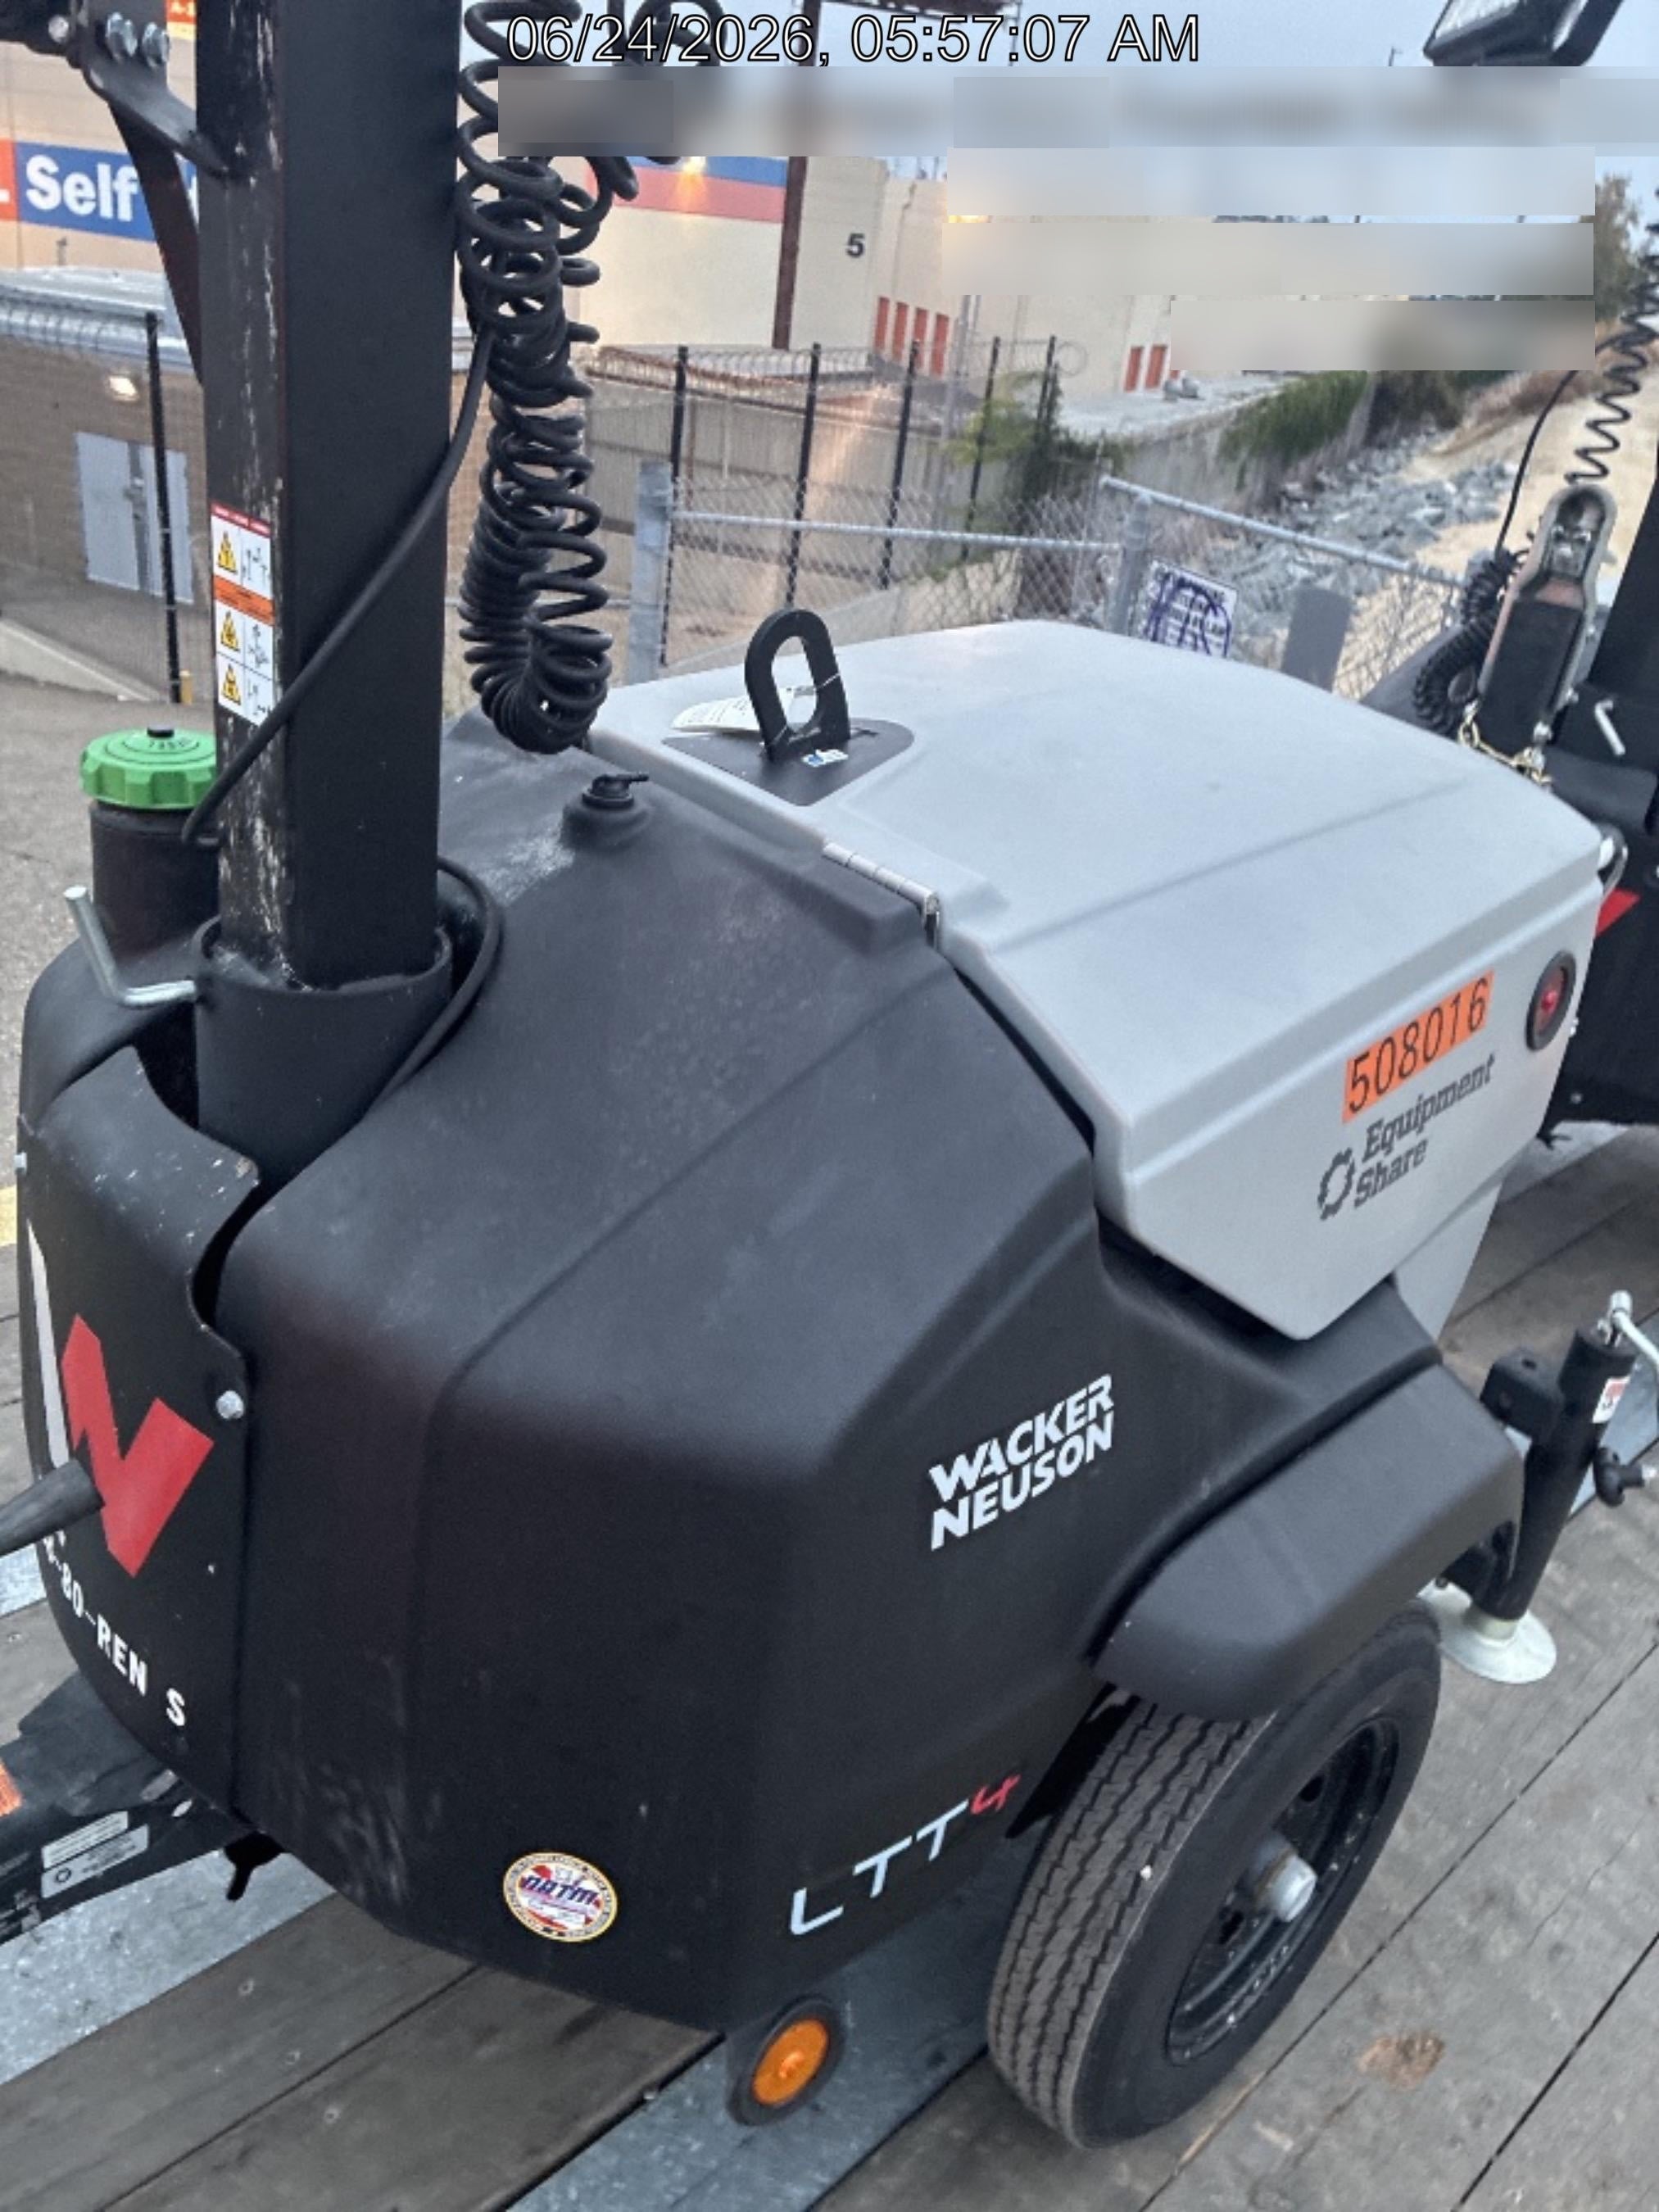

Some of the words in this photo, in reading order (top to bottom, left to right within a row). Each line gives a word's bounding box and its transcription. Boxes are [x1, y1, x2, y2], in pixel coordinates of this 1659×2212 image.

[26, 155, 138, 222] Self
[846, 233, 864, 258] 5
[1349, 977, 1489, 1113] 508016
[1362, 1052, 1495, 1163] Equipment
[1353, 1139, 1428, 1209] Share
[929, 1373, 1114, 1502] WACKER
[931, 1410, 1114, 1552] NEUSON
[166, 1688, 185, 1726] S
[791, 1774, 1022, 1935] LTT4
